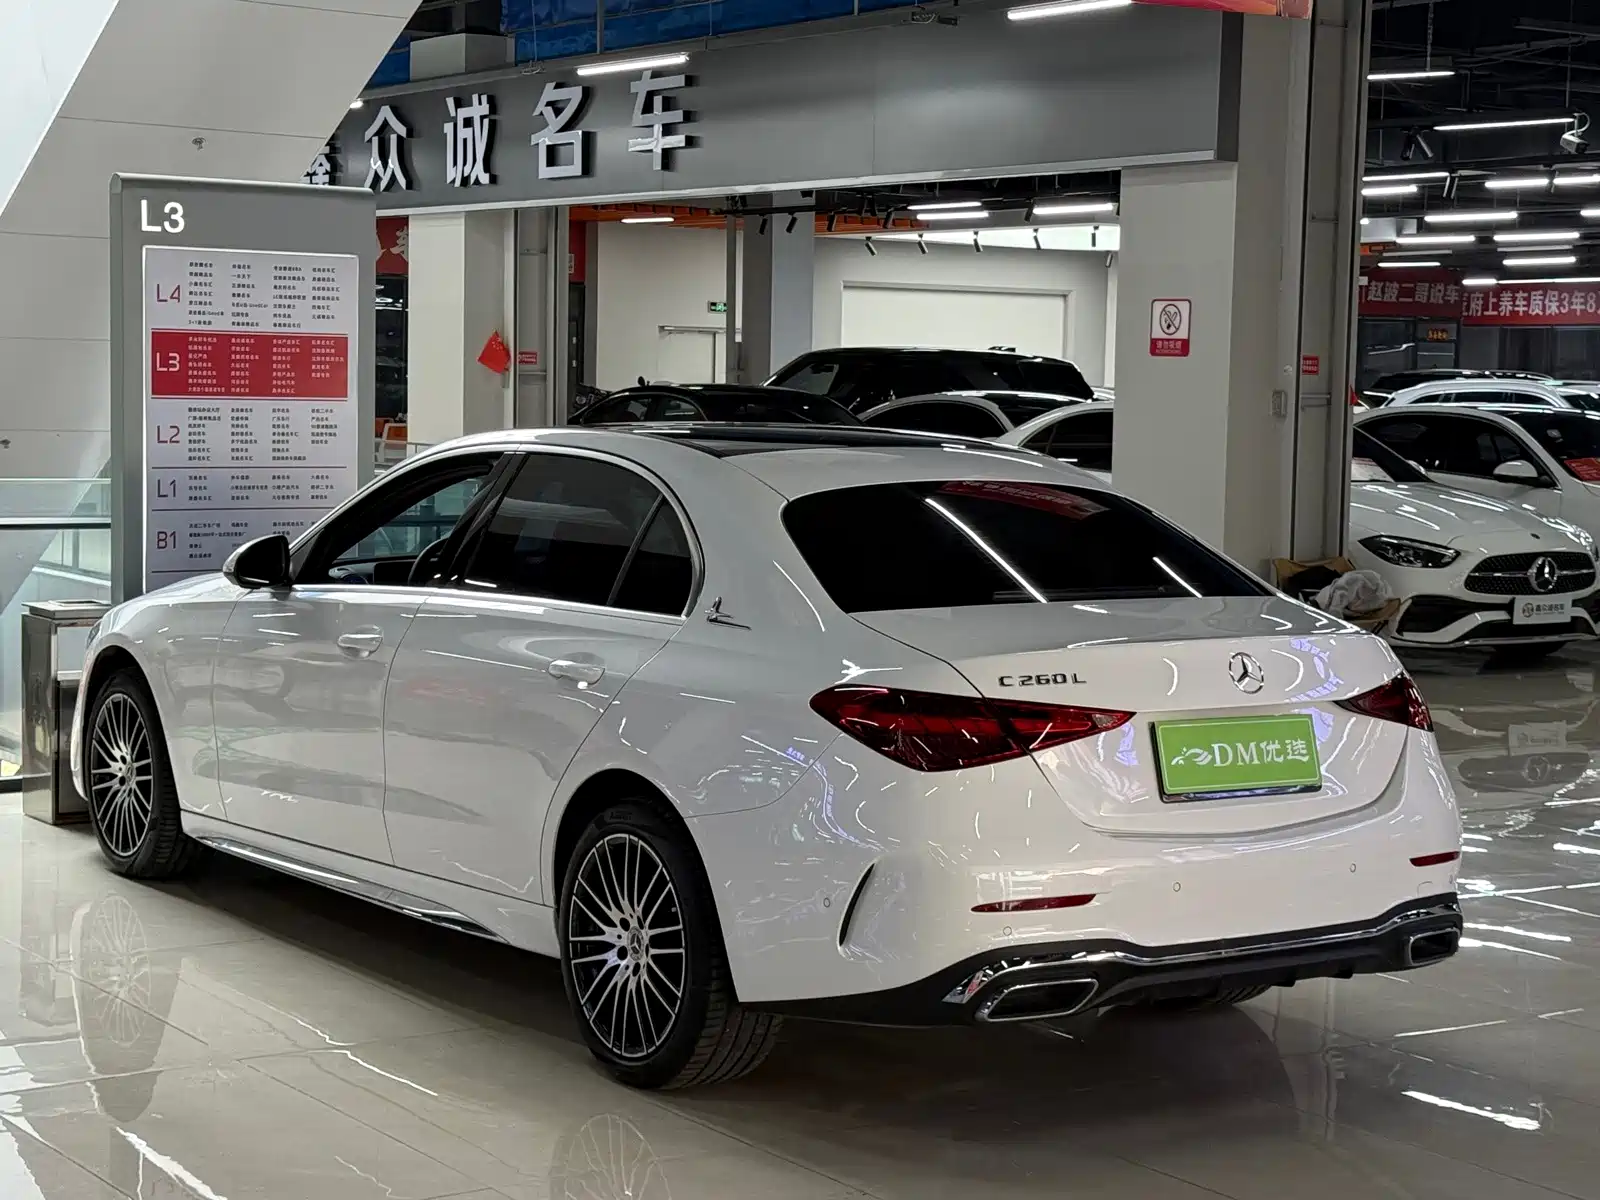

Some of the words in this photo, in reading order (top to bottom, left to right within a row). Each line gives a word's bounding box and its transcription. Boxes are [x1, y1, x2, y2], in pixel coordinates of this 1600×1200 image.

[140, 199, 185, 234] L3
[156, 284, 181, 303] L4
[1462, 289, 1600, 317] 府上养车质保3年8
[156, 352, 180, 372] L3
[157, 425, 181, 444] L2
[157, 479, 177, 498] L1
[157, 531, 177, 550] B1
[1212, 739, 1308, 767] DM优选
